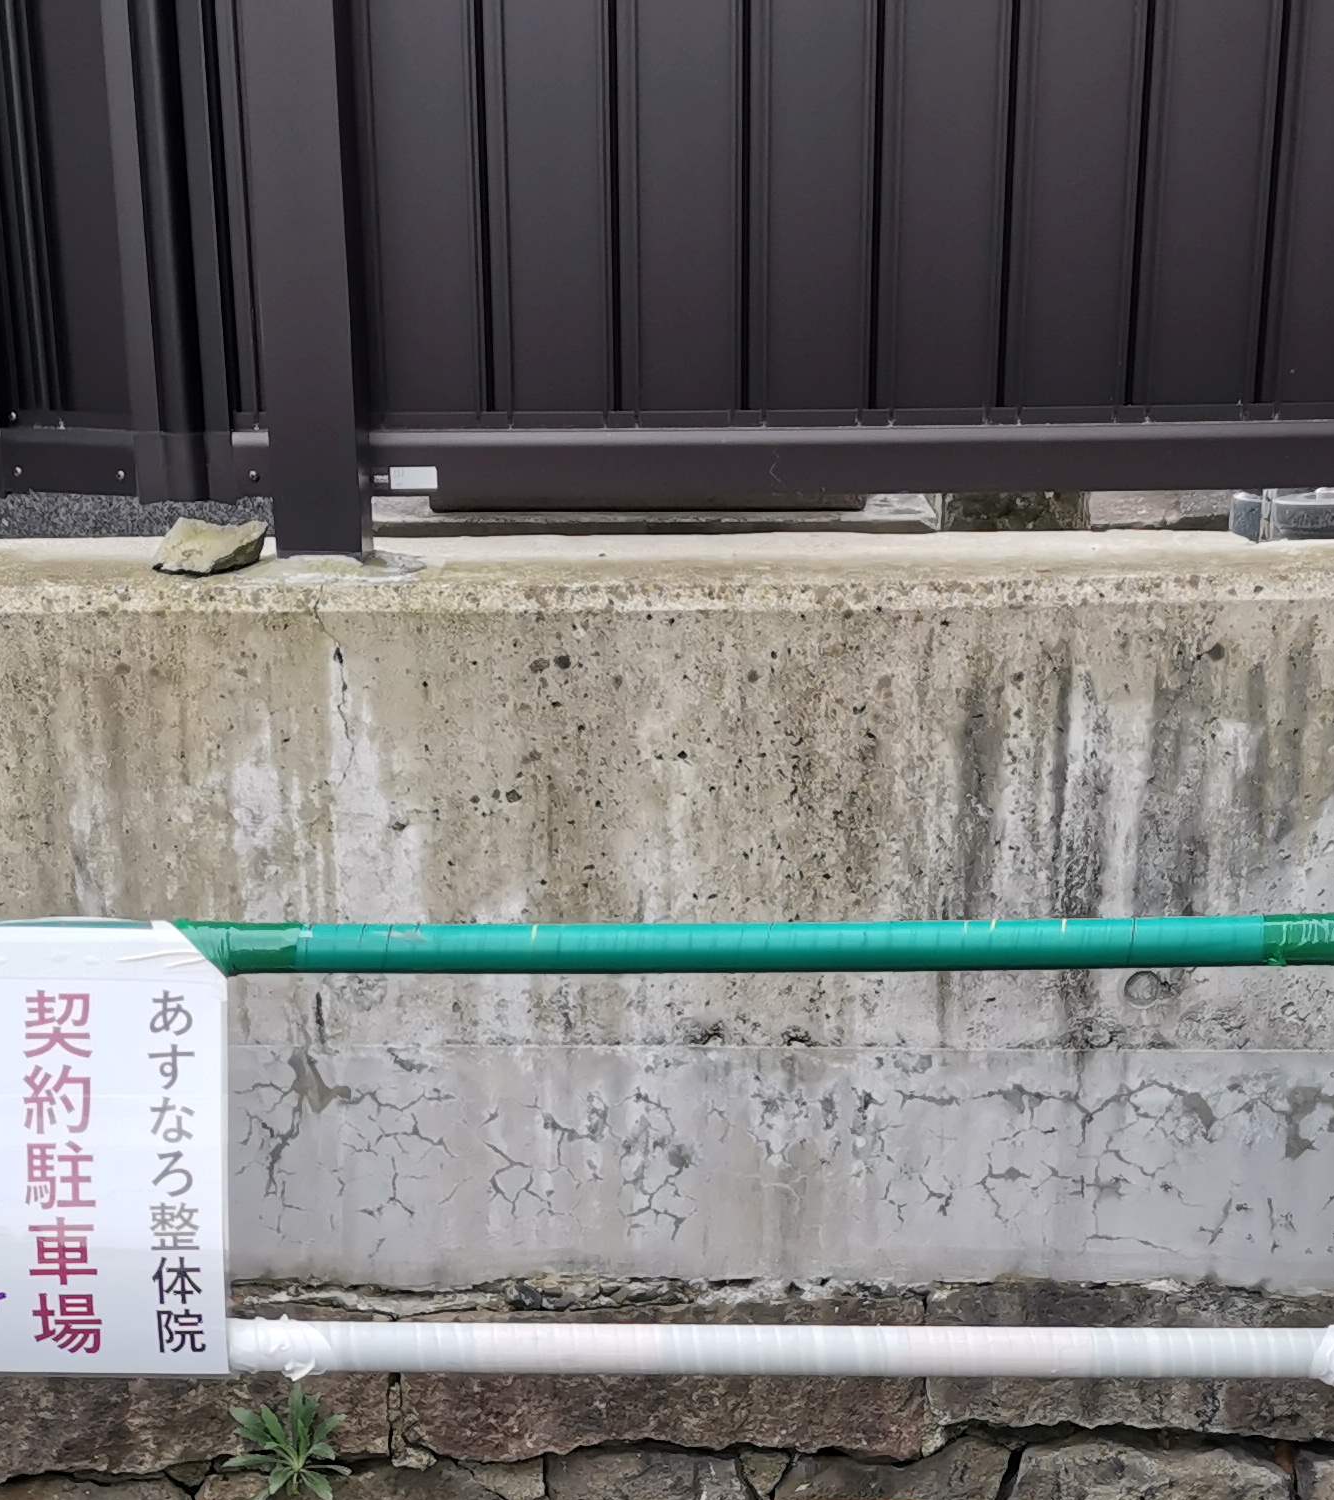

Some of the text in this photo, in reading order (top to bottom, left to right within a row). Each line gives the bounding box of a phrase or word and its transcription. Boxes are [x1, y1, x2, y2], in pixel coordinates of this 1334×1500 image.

[23, 989, 103, 1354] 契約駐車場
[148, 989, 206, 1354] あすなろ整体院
